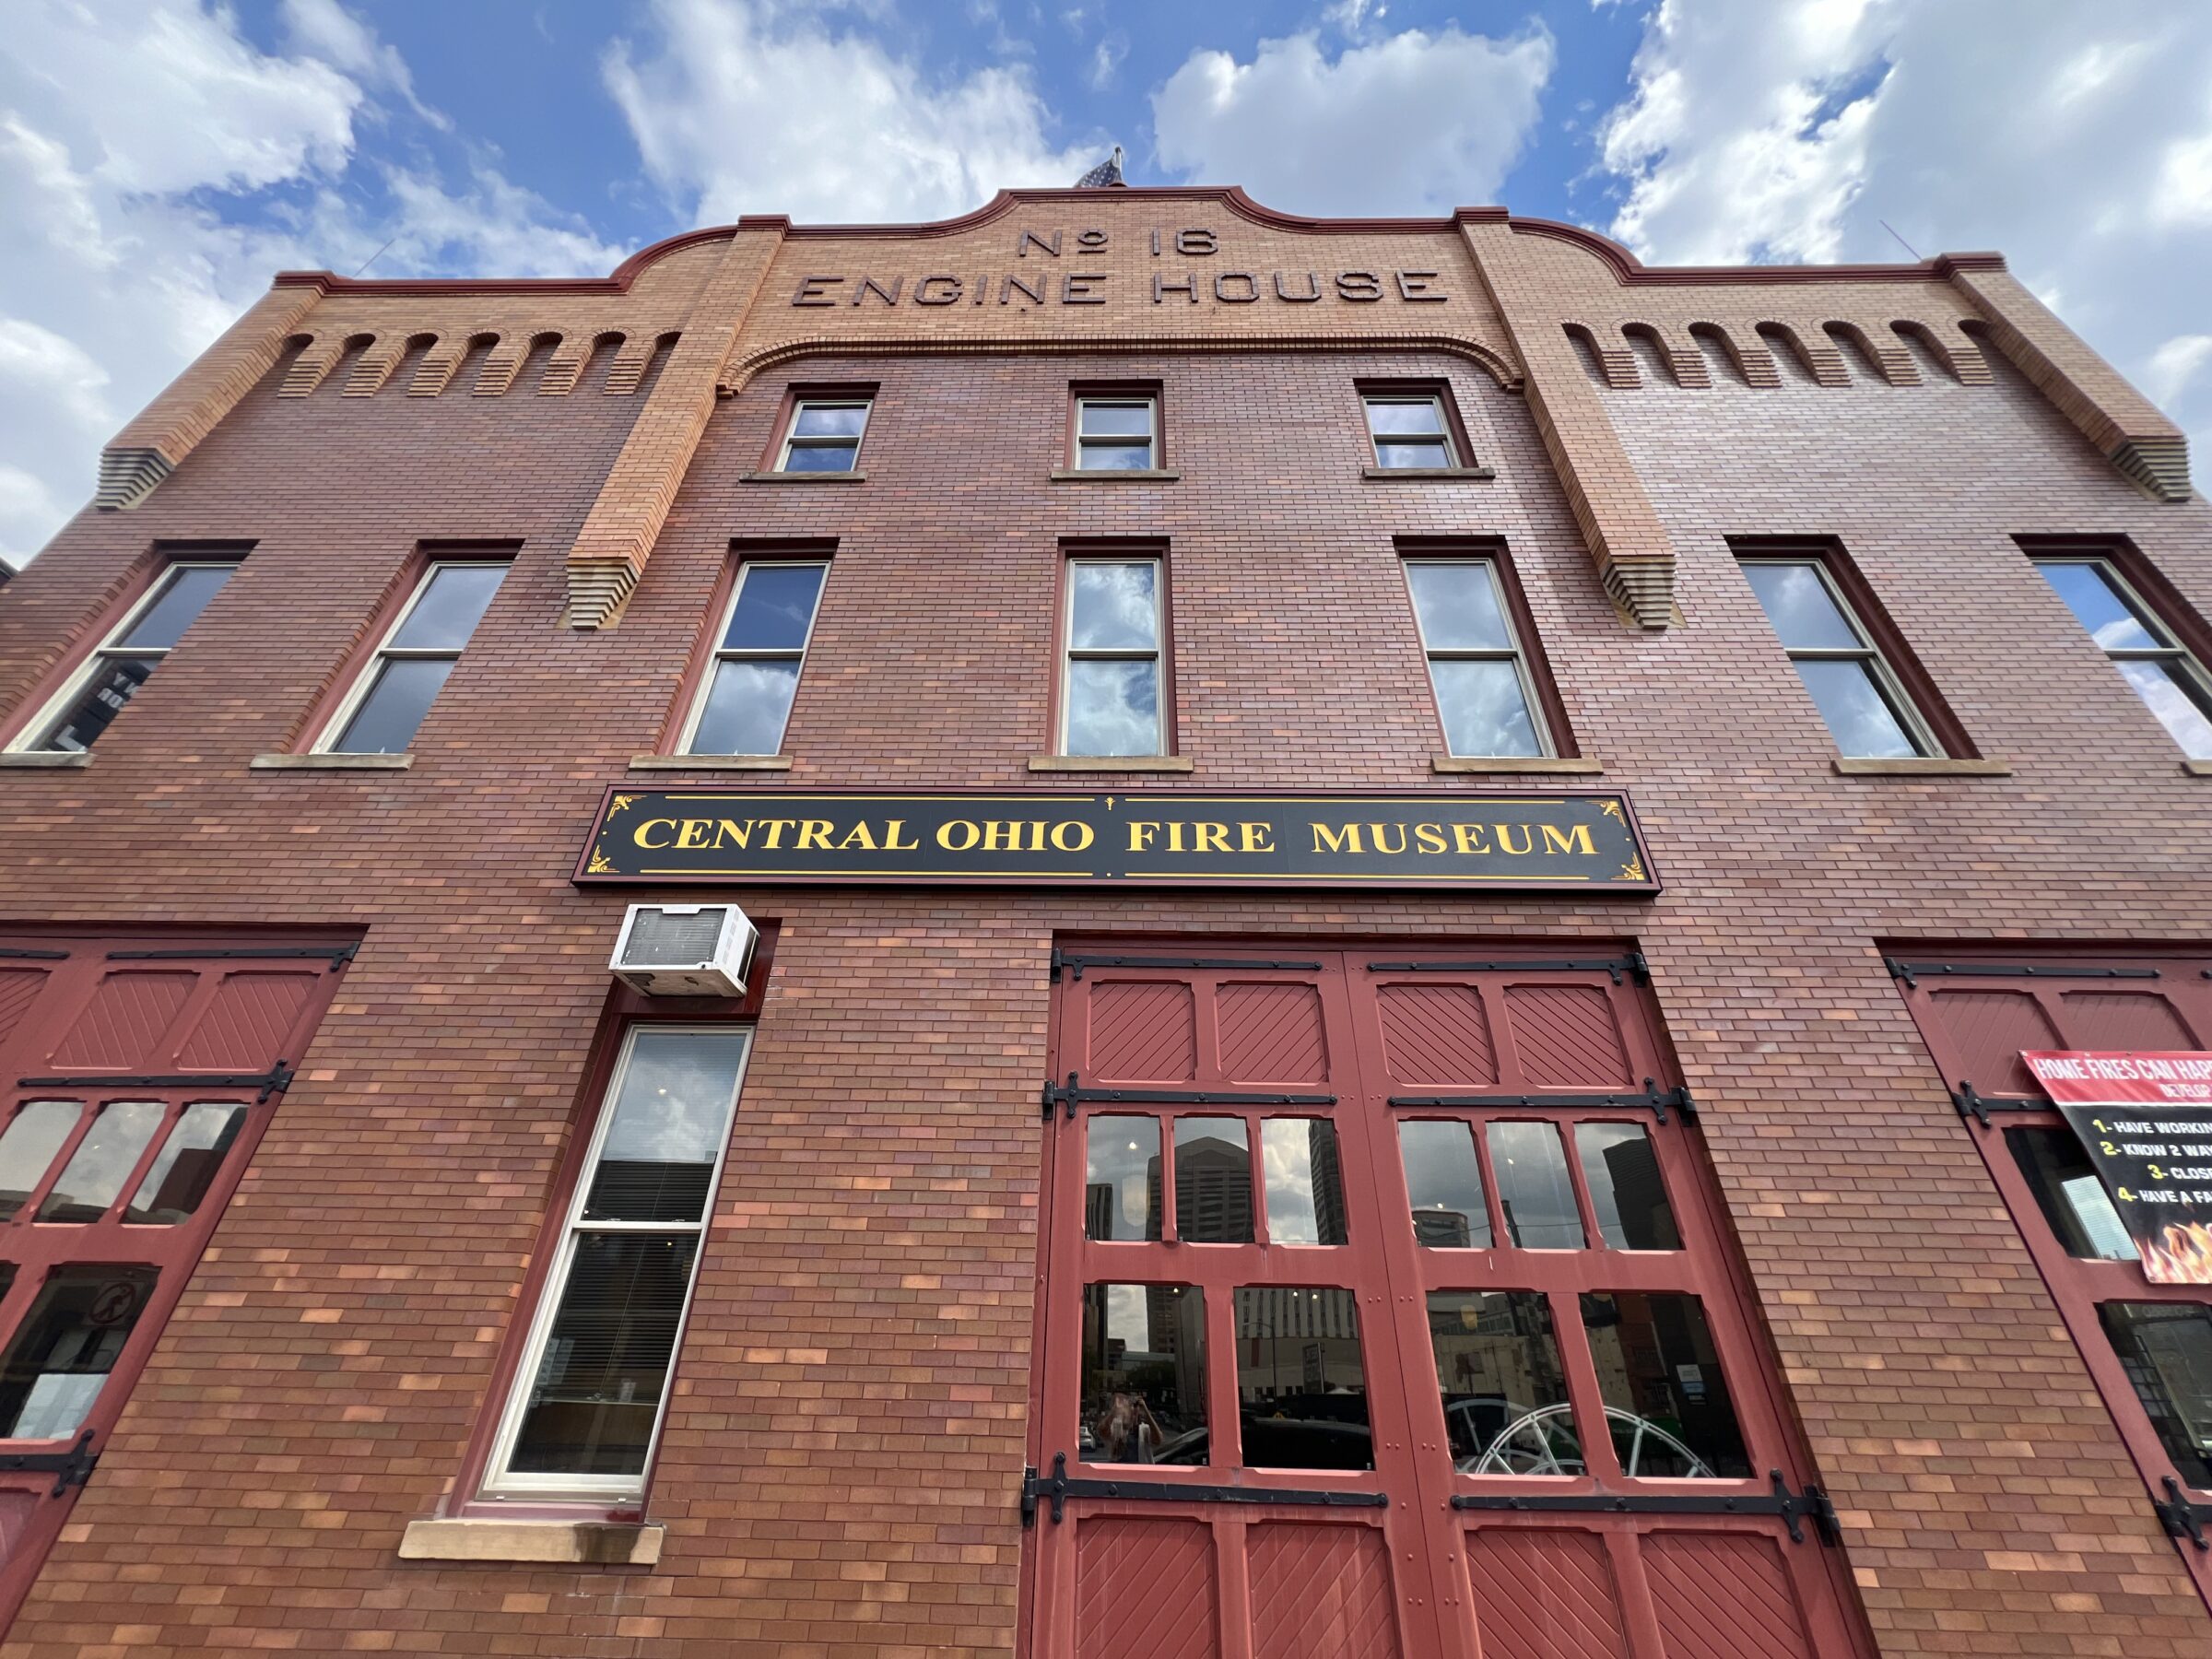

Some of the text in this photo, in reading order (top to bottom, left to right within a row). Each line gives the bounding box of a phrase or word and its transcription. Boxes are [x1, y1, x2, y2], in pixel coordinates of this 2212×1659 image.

[1152, 229, 1218, 257] 16
[792, 271, 1448, 307] ENGINE HOUSE
[633, 818, 1600, 854] CENTRAL OHIO FIRE MUSEUM
[2033, 1059, 2089, 1079] HOME
[2084, 1059, 2139, 1080] FIRES
[2131, 1059, 2178, 1080] CAN
[2159, 1083, 2211, 1098] DEVELOP
[2113, 1122, 2154, 1134] HAVE
[2122, 1144, 2168, 1156] KNOW
[2169, 1145, 2182, 1157] 2
[2138, 1190, 2179, 1203] HAVE
[2180, 1191, 2194, 1204] A
